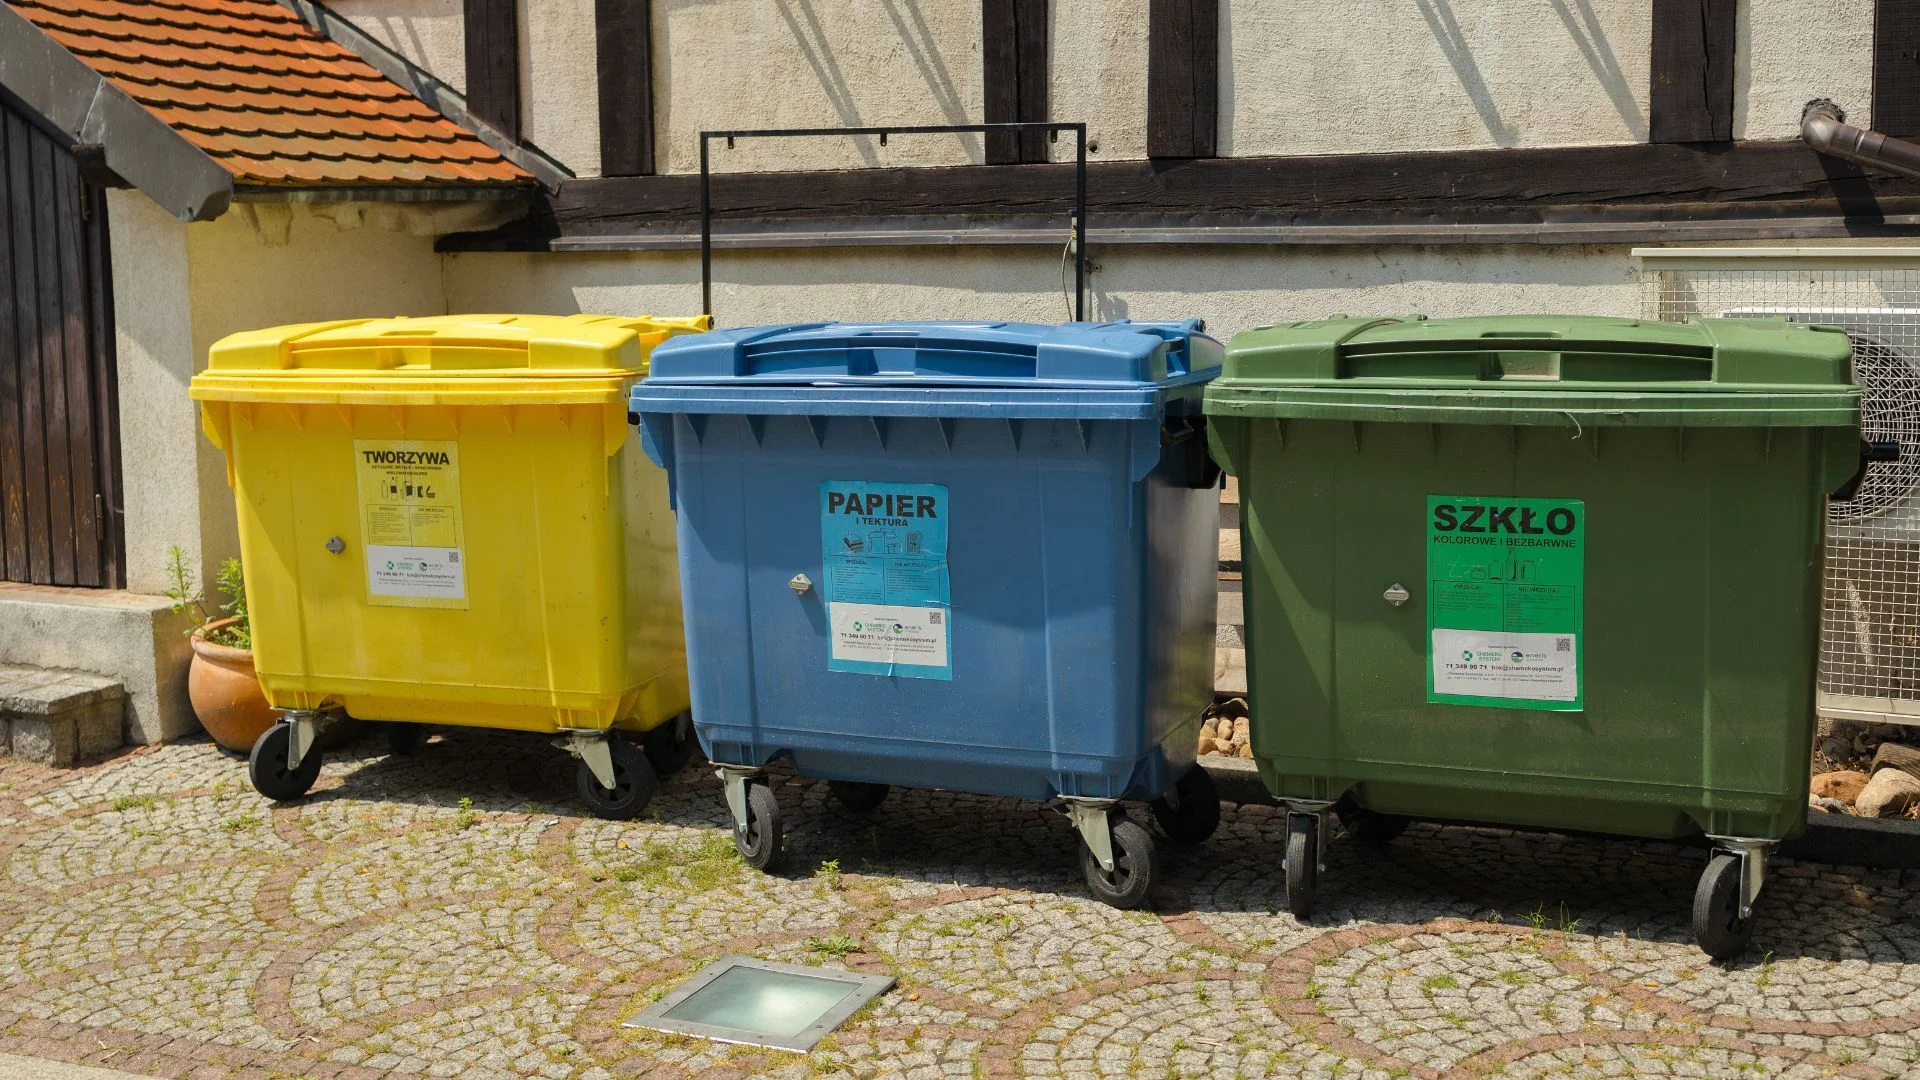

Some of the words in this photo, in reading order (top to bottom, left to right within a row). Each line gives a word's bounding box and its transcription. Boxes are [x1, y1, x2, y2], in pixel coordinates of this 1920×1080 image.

[362, 450, 450, 465] TWORZYWA
[828, 492, 937, 518] PAPIER
[862, 518, 908, 526] TEKTURA
[1434, 504, 1576, 536] SZKŁO
[1434, 535, 1497, 546] KOLOROWE
[1506, 538, 1576, 548] BEZBARWNE
